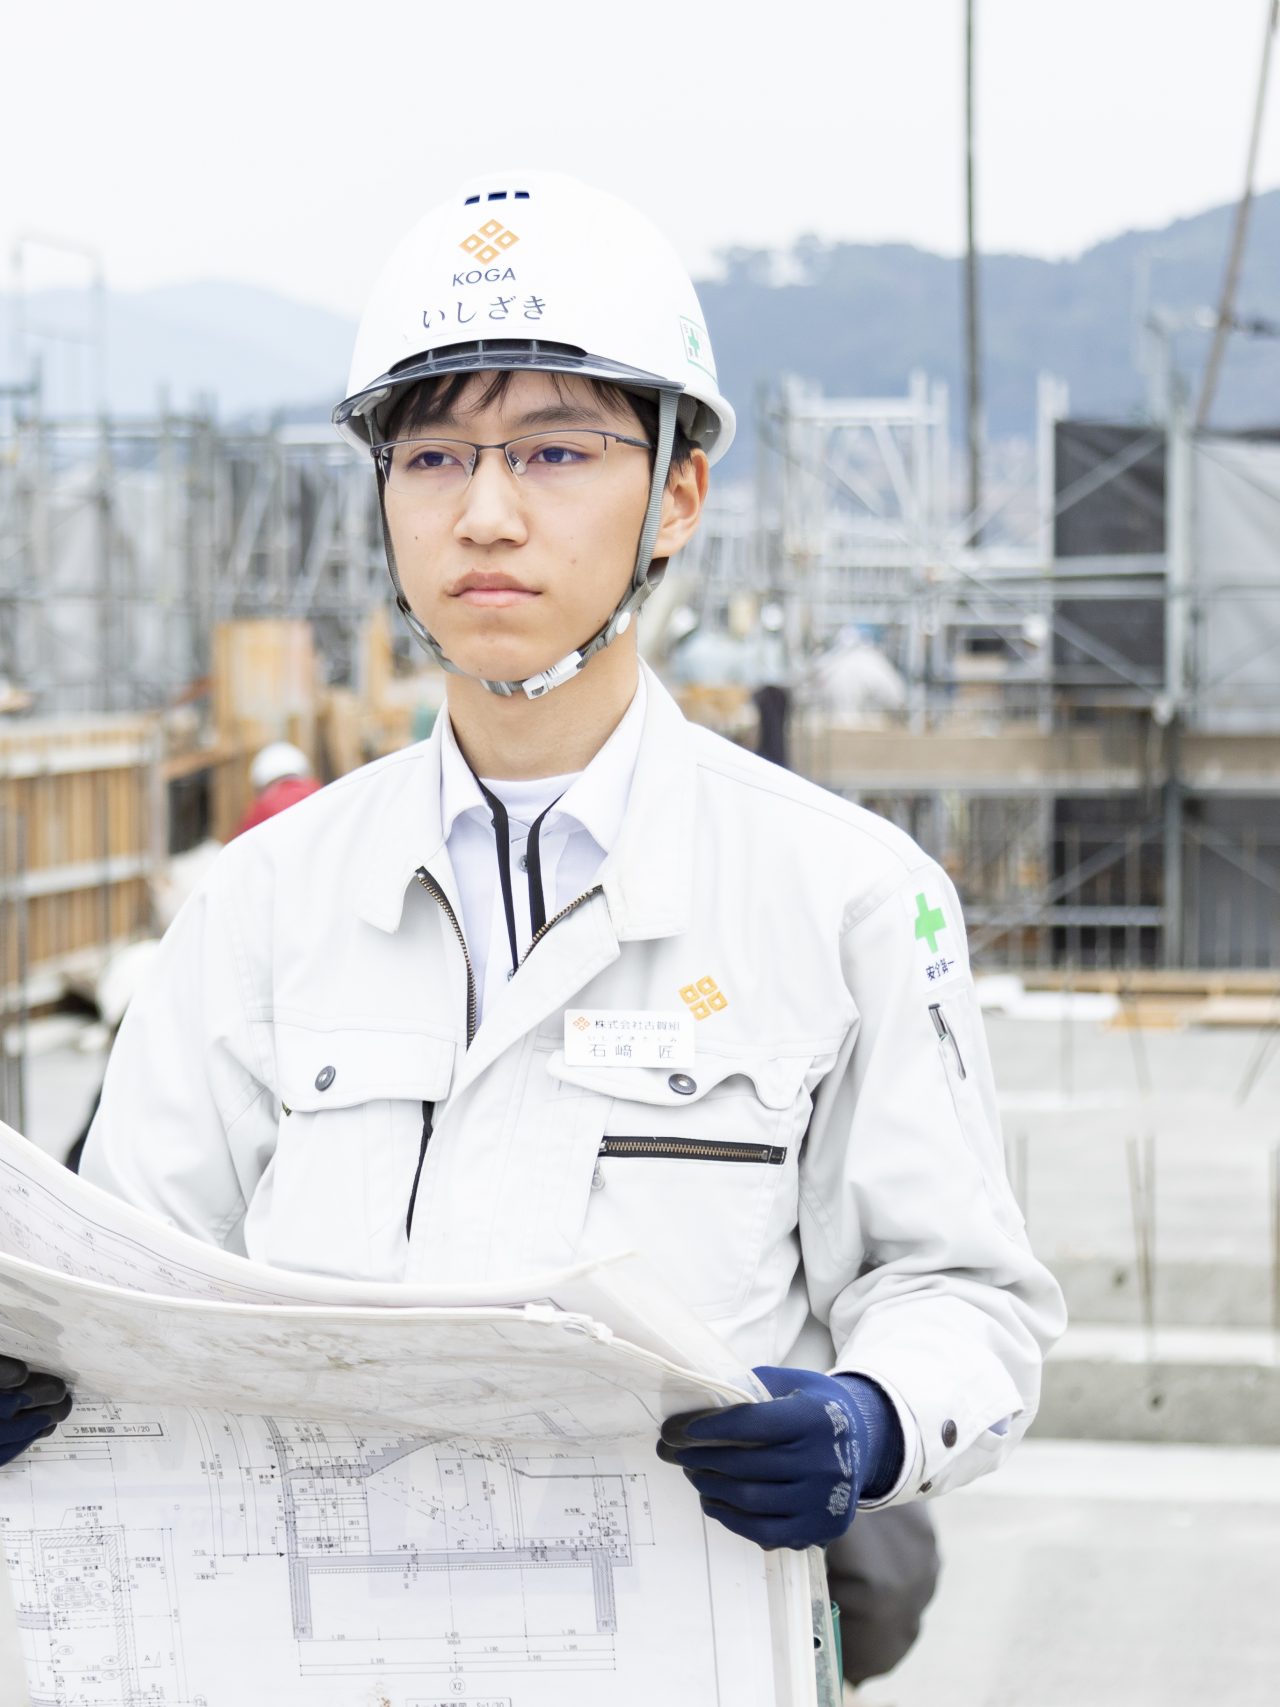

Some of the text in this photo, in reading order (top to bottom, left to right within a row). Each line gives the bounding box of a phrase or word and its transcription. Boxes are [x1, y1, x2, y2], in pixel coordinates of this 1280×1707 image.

[452, 267, 516, 287] KOGA
[422, 295, 546, 328] いしざき
[925, 958, 955, 981] 安全第一
[123, 1425, 151, 1433] S=1/20
